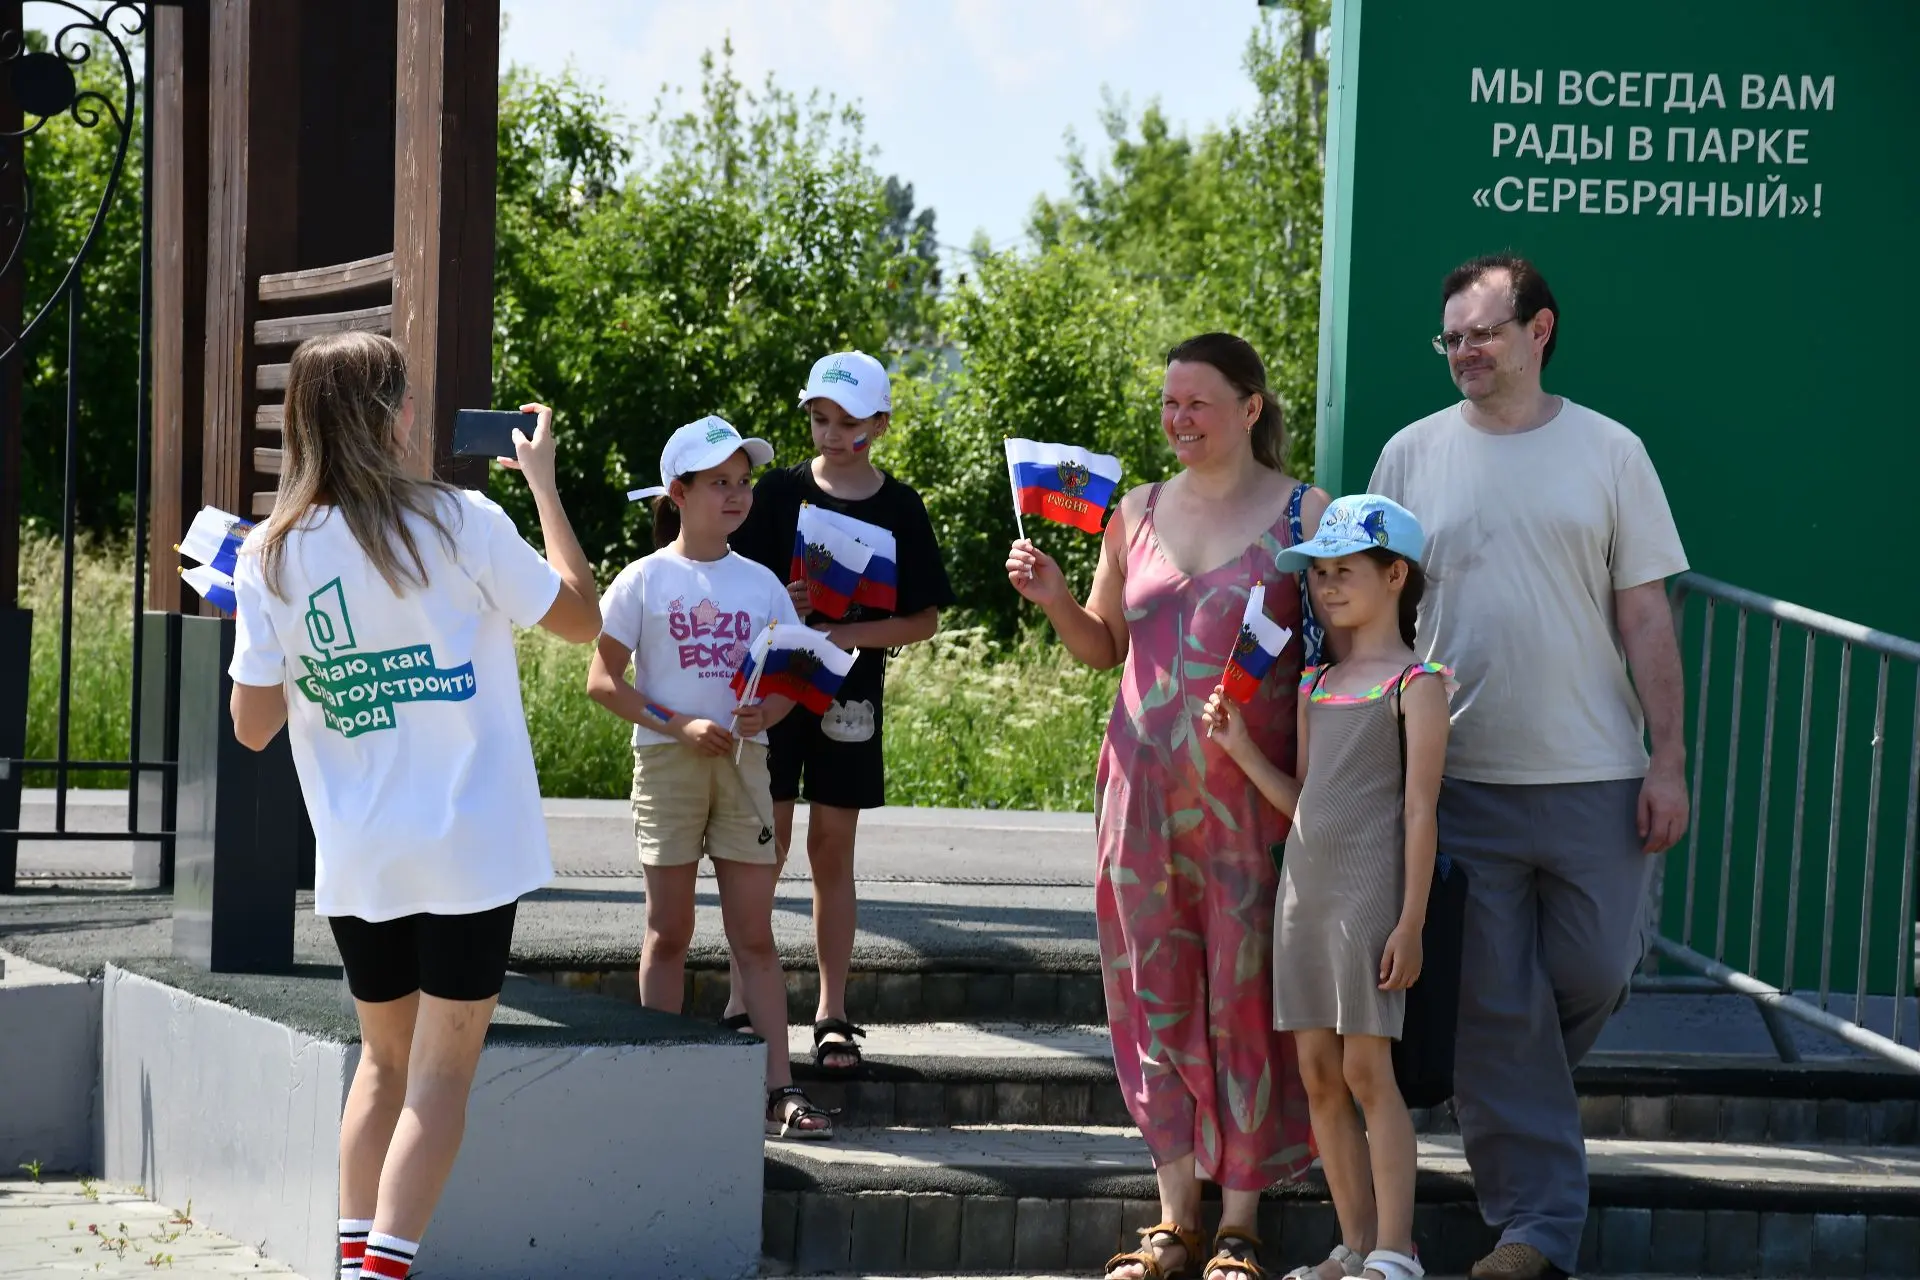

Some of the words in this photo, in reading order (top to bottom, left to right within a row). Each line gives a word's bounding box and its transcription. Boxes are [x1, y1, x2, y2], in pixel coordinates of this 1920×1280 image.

[1470, 68, 1543, 105] МЫ
[1558, 70, 1727, 114] ВСЕГДА
[1741, 74, 1836, 111] ВАМ
[1492, 122, 1613, 165] РАДЫ
[1628, 126, 1654, 161] В
[1667, 127, 1810, 164] ПАРКЕ
[1472, 174, 1823, 218] «СЕРЕБРЯНЫЙ»!
[1047, 493, 1089, 514] РОССИЯ
[308, 657, 377, 683] Знаю,
[383, 650, 431, 672] как
[306, 673, 474, 707] благоустроить
[324, 705, 391, 737] город
